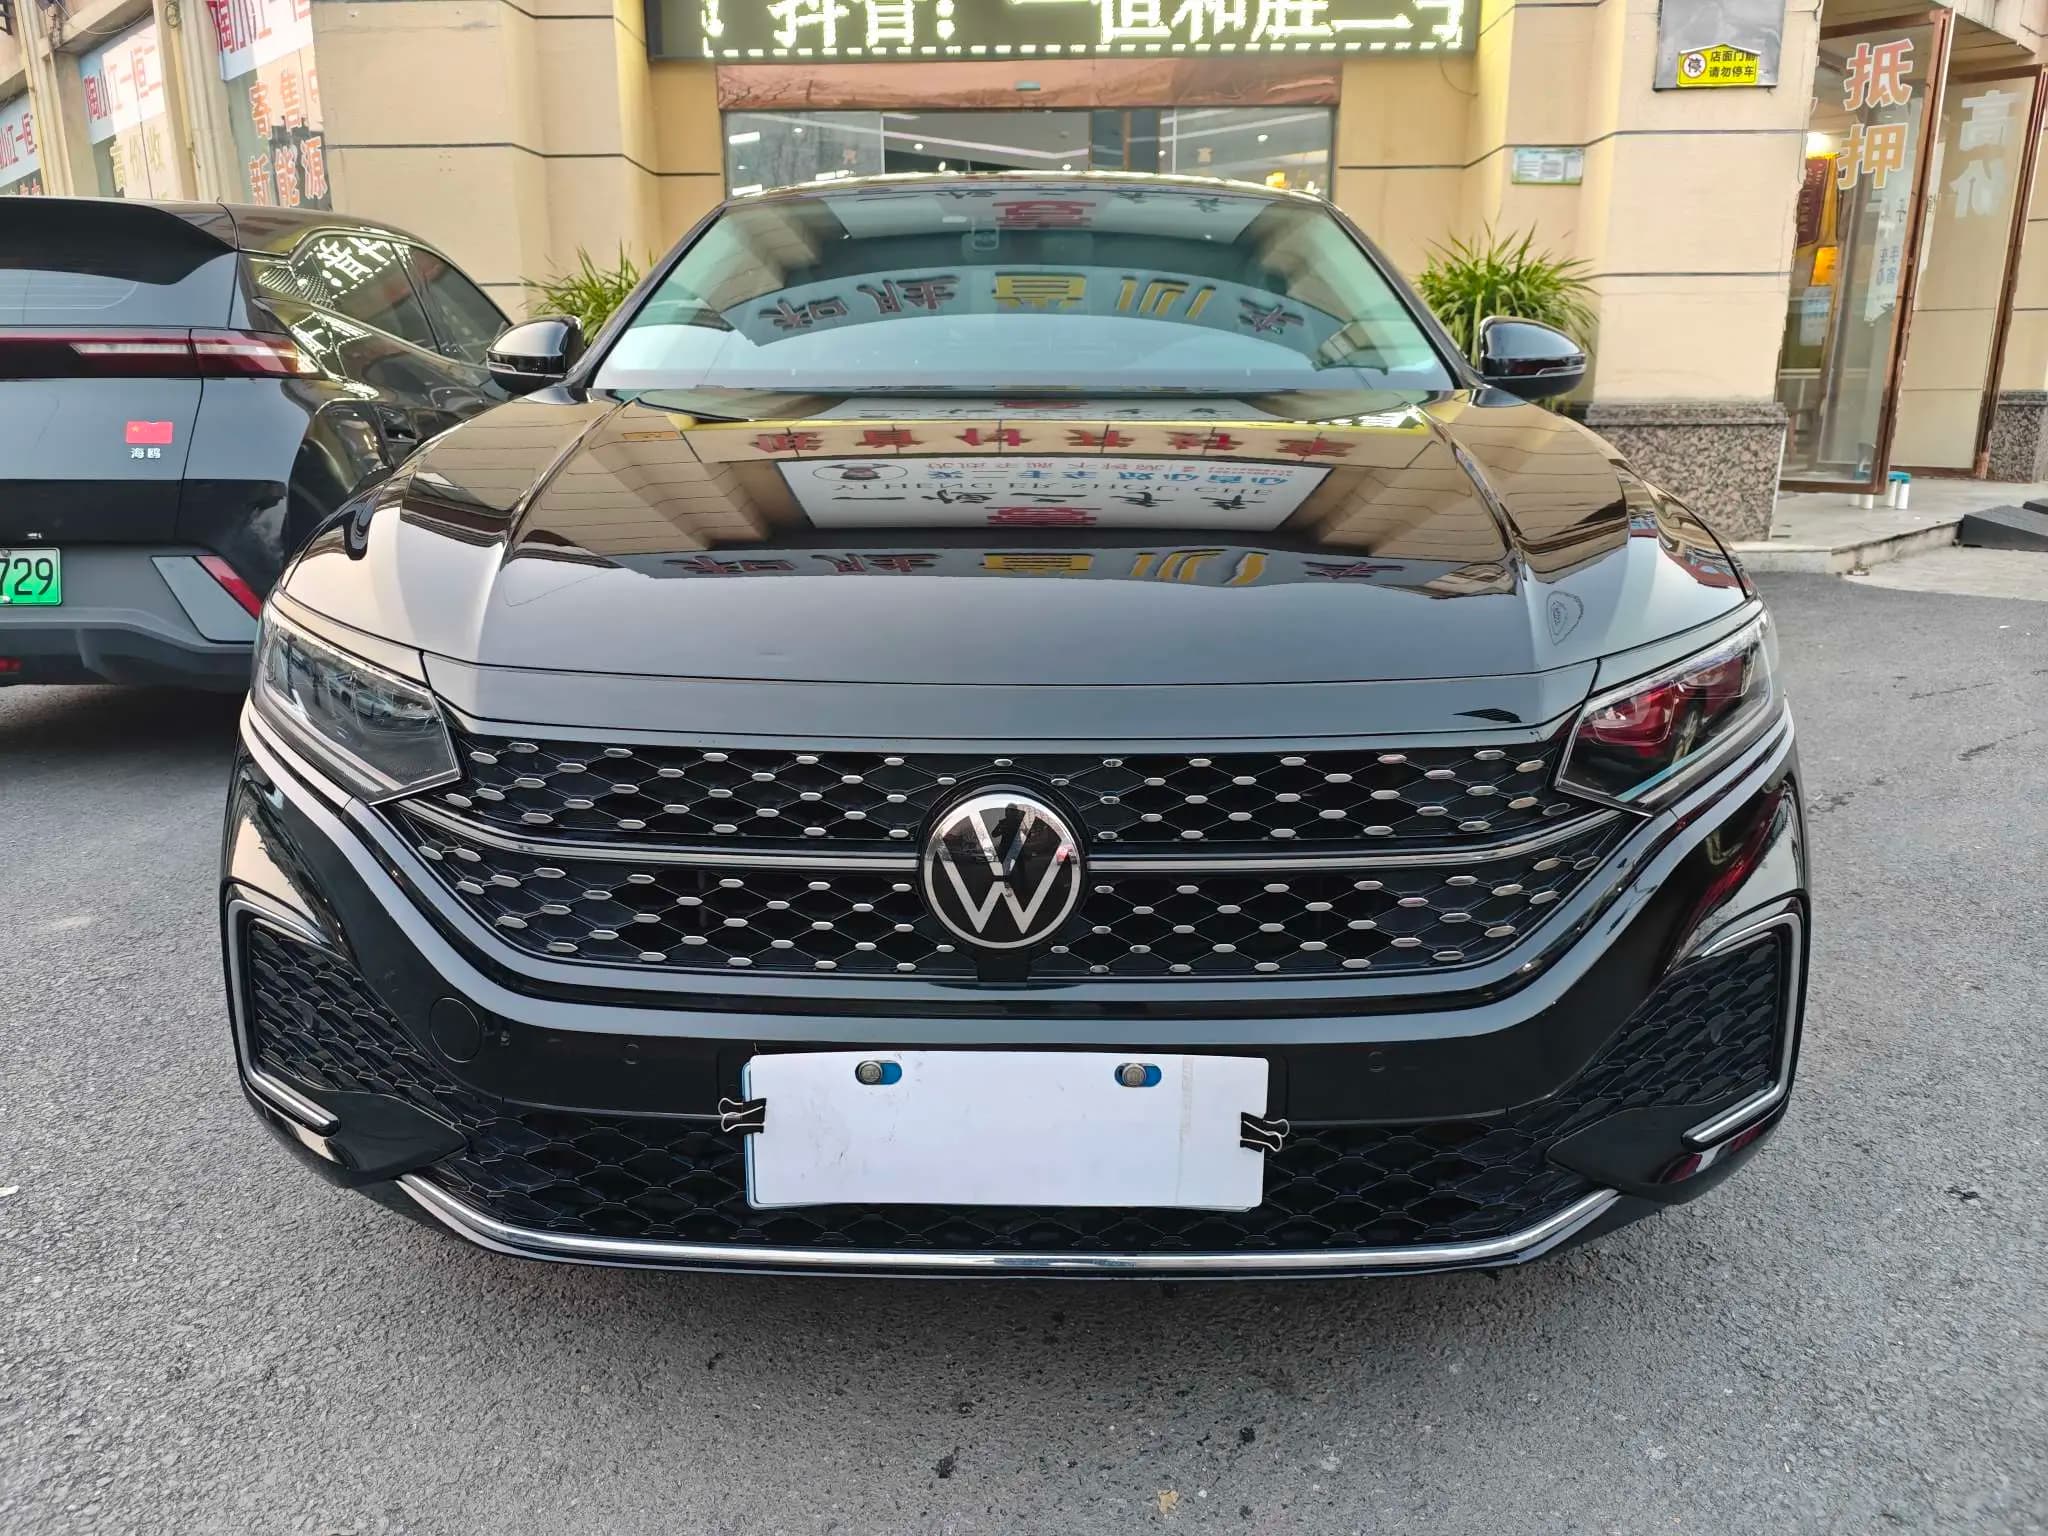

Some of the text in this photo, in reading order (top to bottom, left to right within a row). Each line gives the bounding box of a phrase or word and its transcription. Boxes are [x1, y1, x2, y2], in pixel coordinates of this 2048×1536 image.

[1709, 66, 1754, 78] 请勿停车
[1836, 37, 1914, 190] 抵押
[249, 136, 327, 206] 新能源
